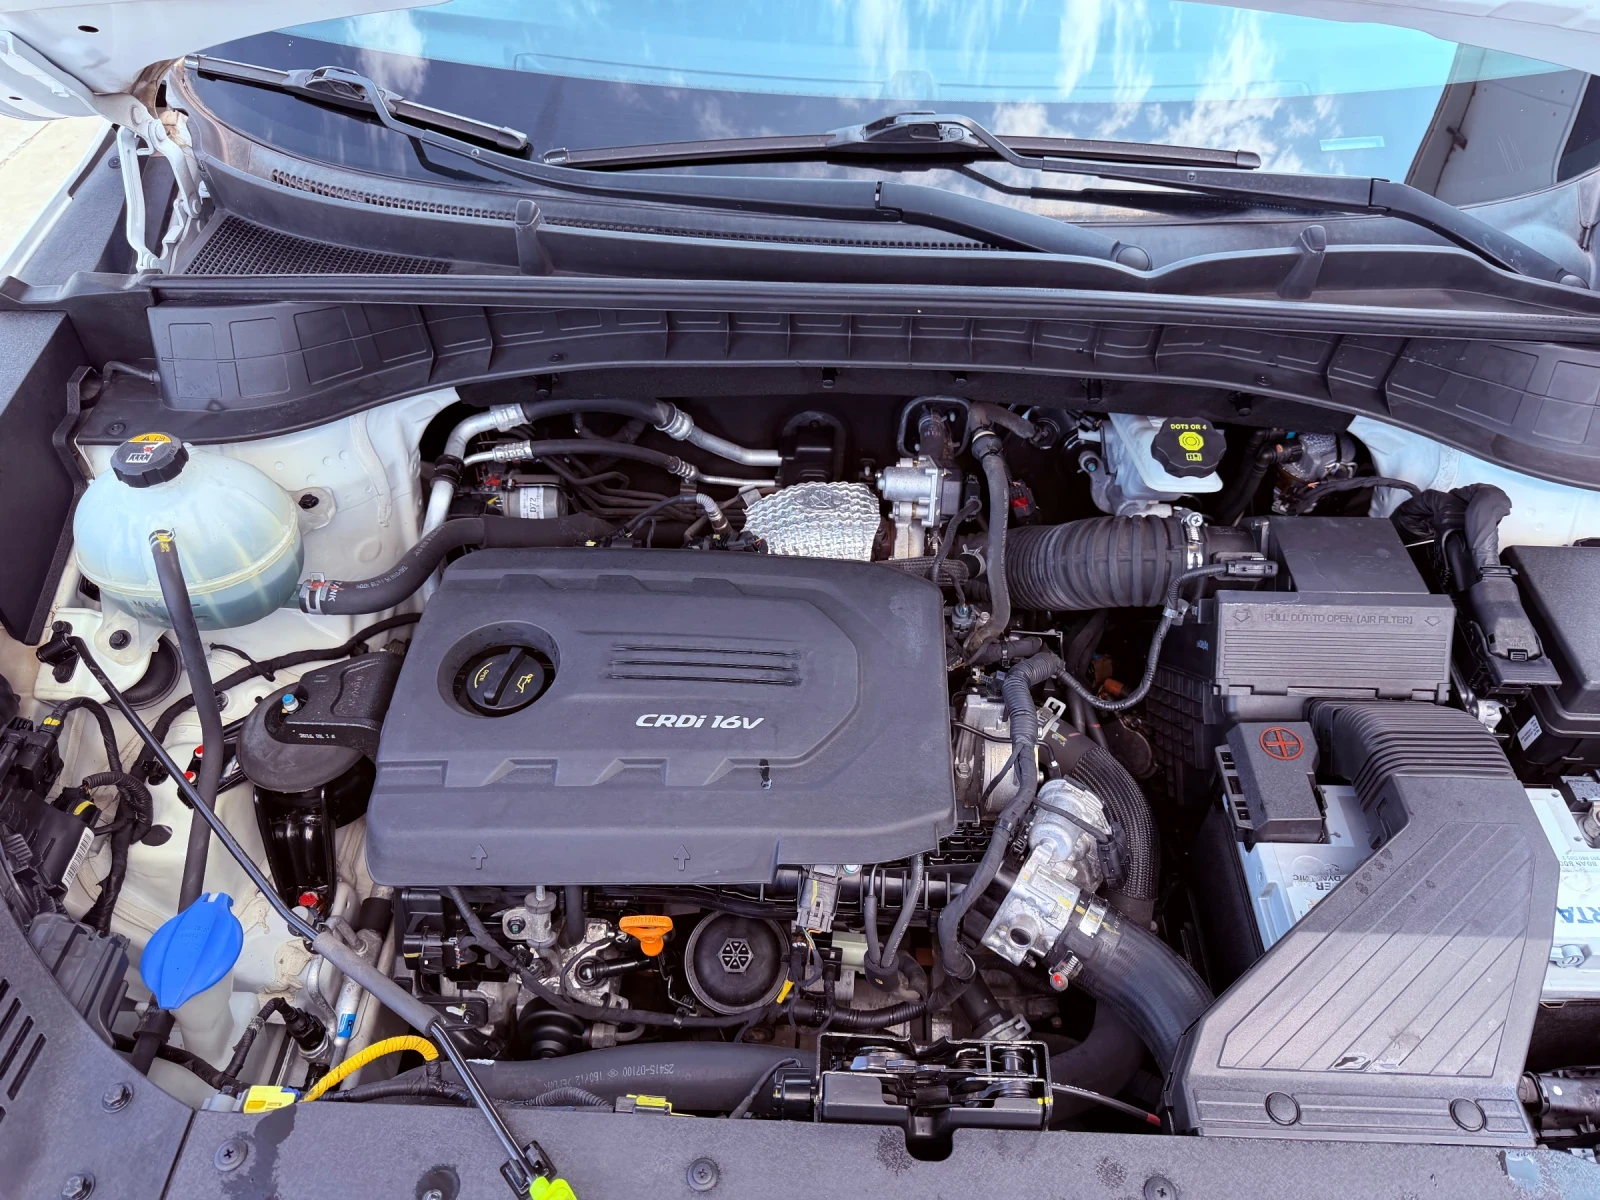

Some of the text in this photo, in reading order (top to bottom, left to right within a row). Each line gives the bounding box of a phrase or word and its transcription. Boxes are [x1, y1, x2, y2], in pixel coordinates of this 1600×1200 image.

[327, 581, 343, 602] TANK
[1264, 613, 1289, 622] PULL
[1290, 613, 1310, 622] OUT
[1312, 614, 1325, 622] TO
[1326, 614, 1353, 623] OPEN
[635, 713, 765, 730] CRDi 16V
[1292, 874, 1341, 882] DYNMIC
